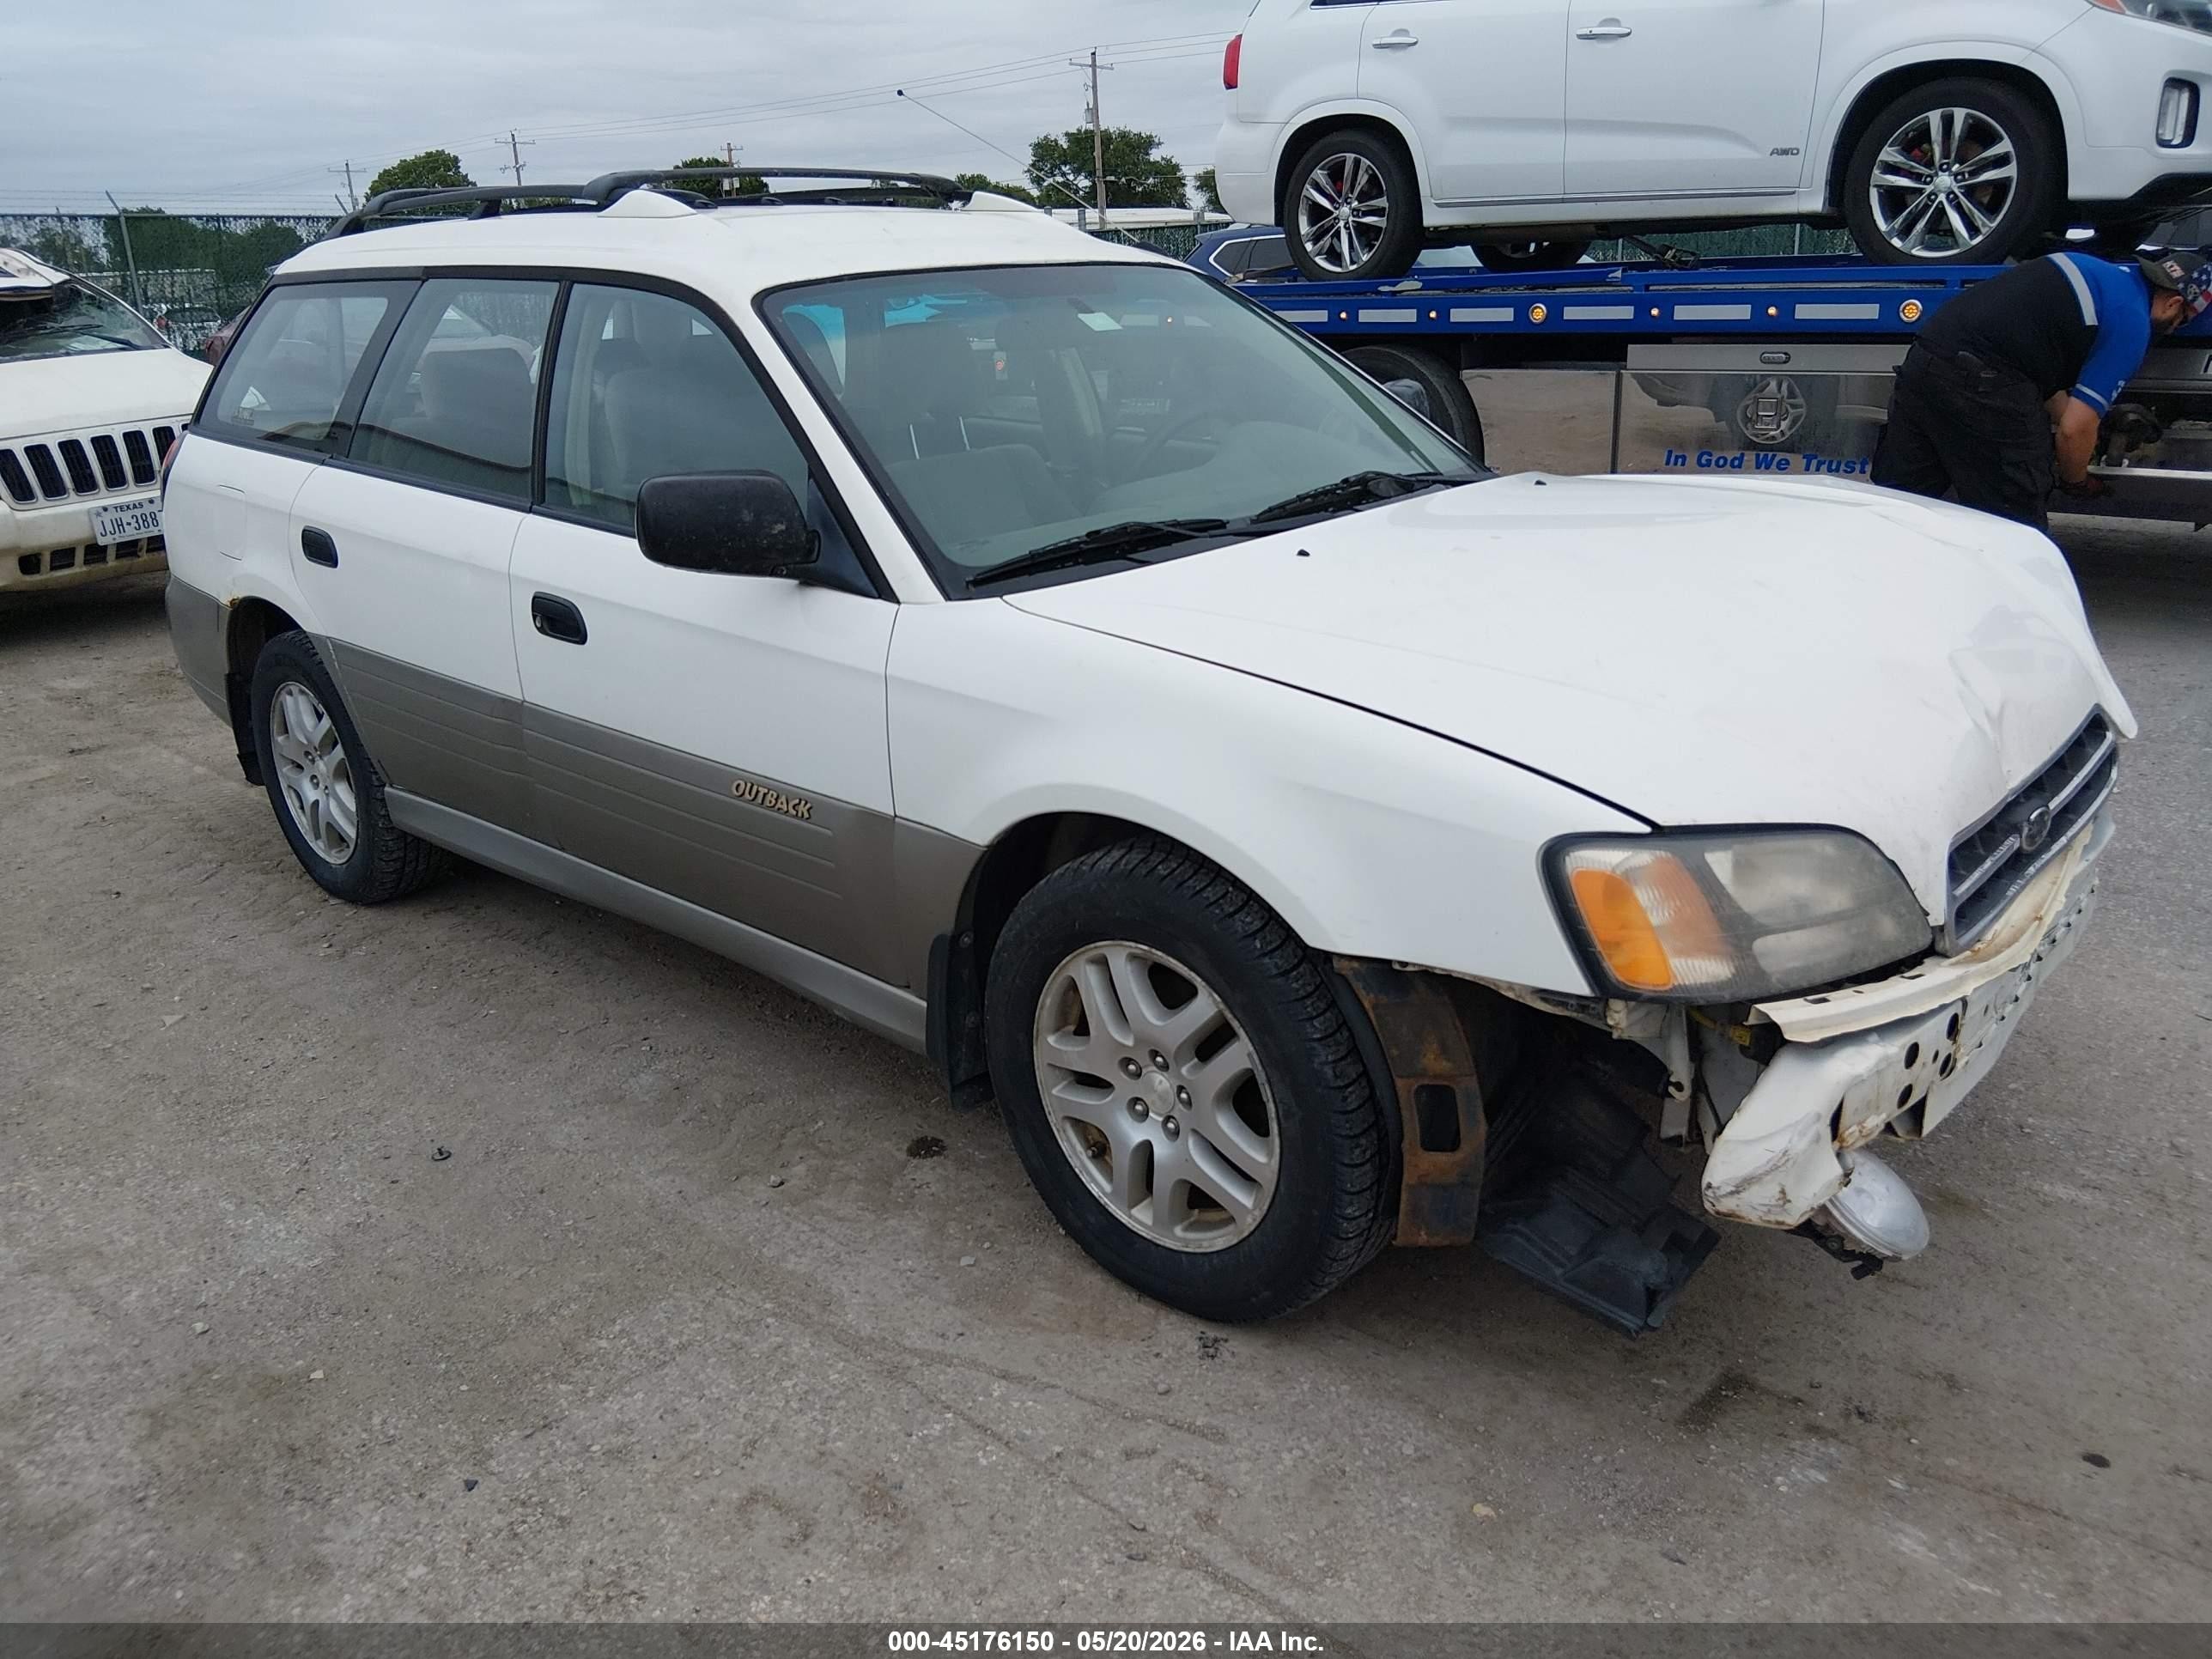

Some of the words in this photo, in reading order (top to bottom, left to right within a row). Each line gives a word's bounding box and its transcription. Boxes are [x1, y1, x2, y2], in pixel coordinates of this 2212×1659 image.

[1770, 147, 1800, 156] AWD
[1664, 449, 1687, 467] In
[1696, 450, 1745, 469] God
[1754, 453, 1790, 471] We
[1802, 453, 1869, 474] Trust
[112, 501, 144, 514] TEXAS
[732, 779, 813, 820] OUTBACK
